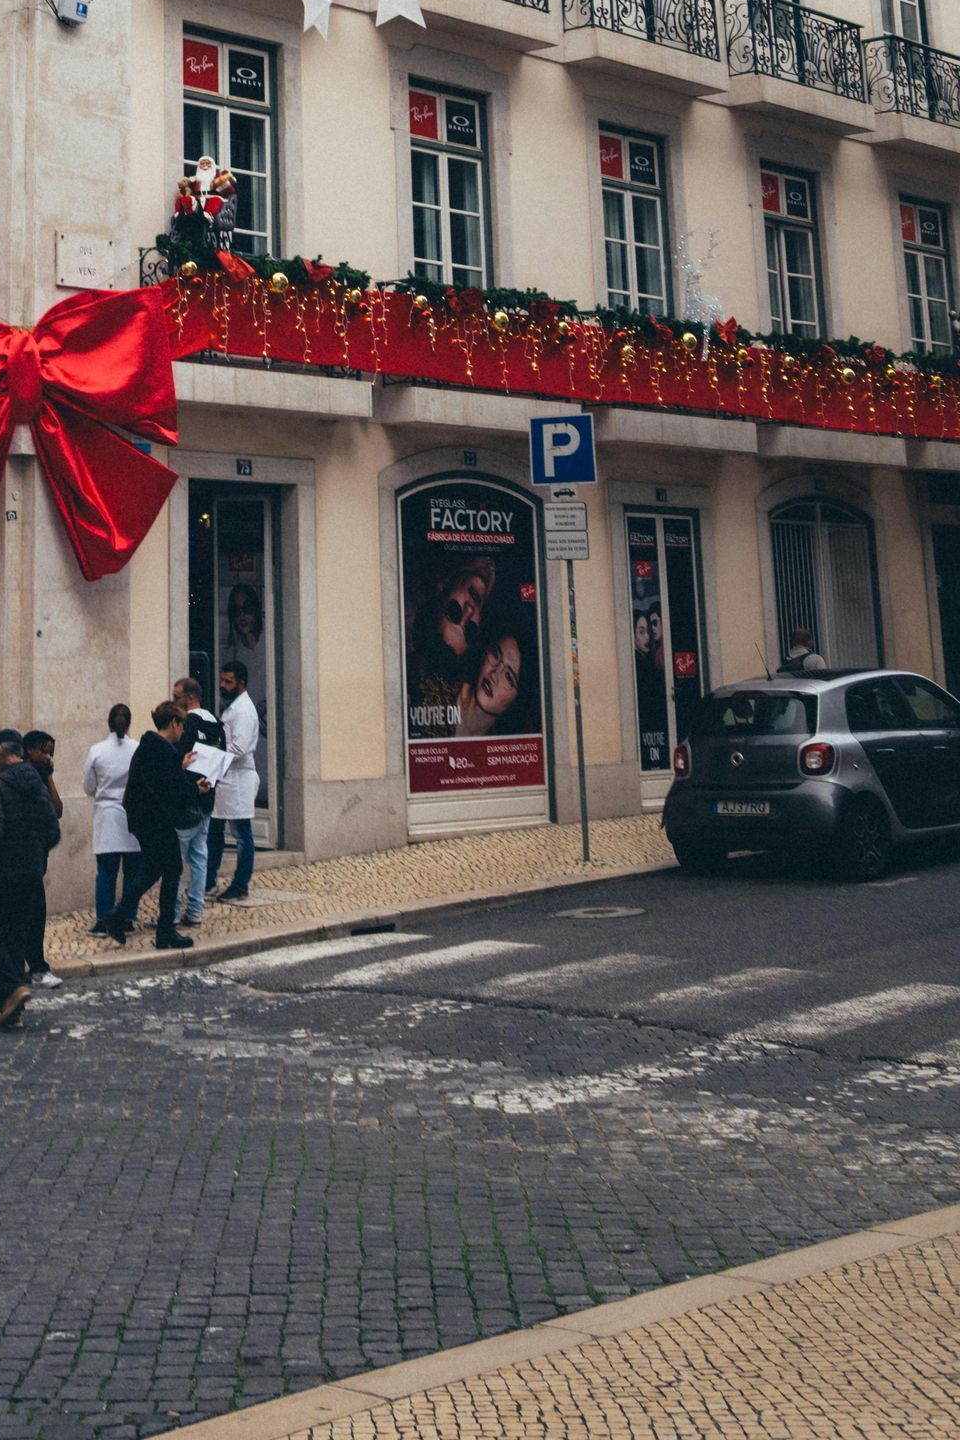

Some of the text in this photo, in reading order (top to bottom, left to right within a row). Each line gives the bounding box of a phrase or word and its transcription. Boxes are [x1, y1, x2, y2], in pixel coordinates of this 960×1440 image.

[186, 55, 214, 74] Ray-Ban
[231, 76, 262, 87] OAKLEY
[410, 104, 434, 122] Ray-Ban
[448, 123, 474, 134] OAKLEY
[542, 422, 581, 478] P
[430, 499, 466, 508] EYEGLASS
[430, 508, 514, 532] FACTORY
[409, 705, 462, 726] YOU'RE ON
[642, 732, 665, 746] YOU'RE
[486, 744, 508, 753] EXAMES
[649, 747, 660, 761] ON
[456, 757, 468, 769] 20
[487, 753, 539, 766] SEM MARCAÇÃO
